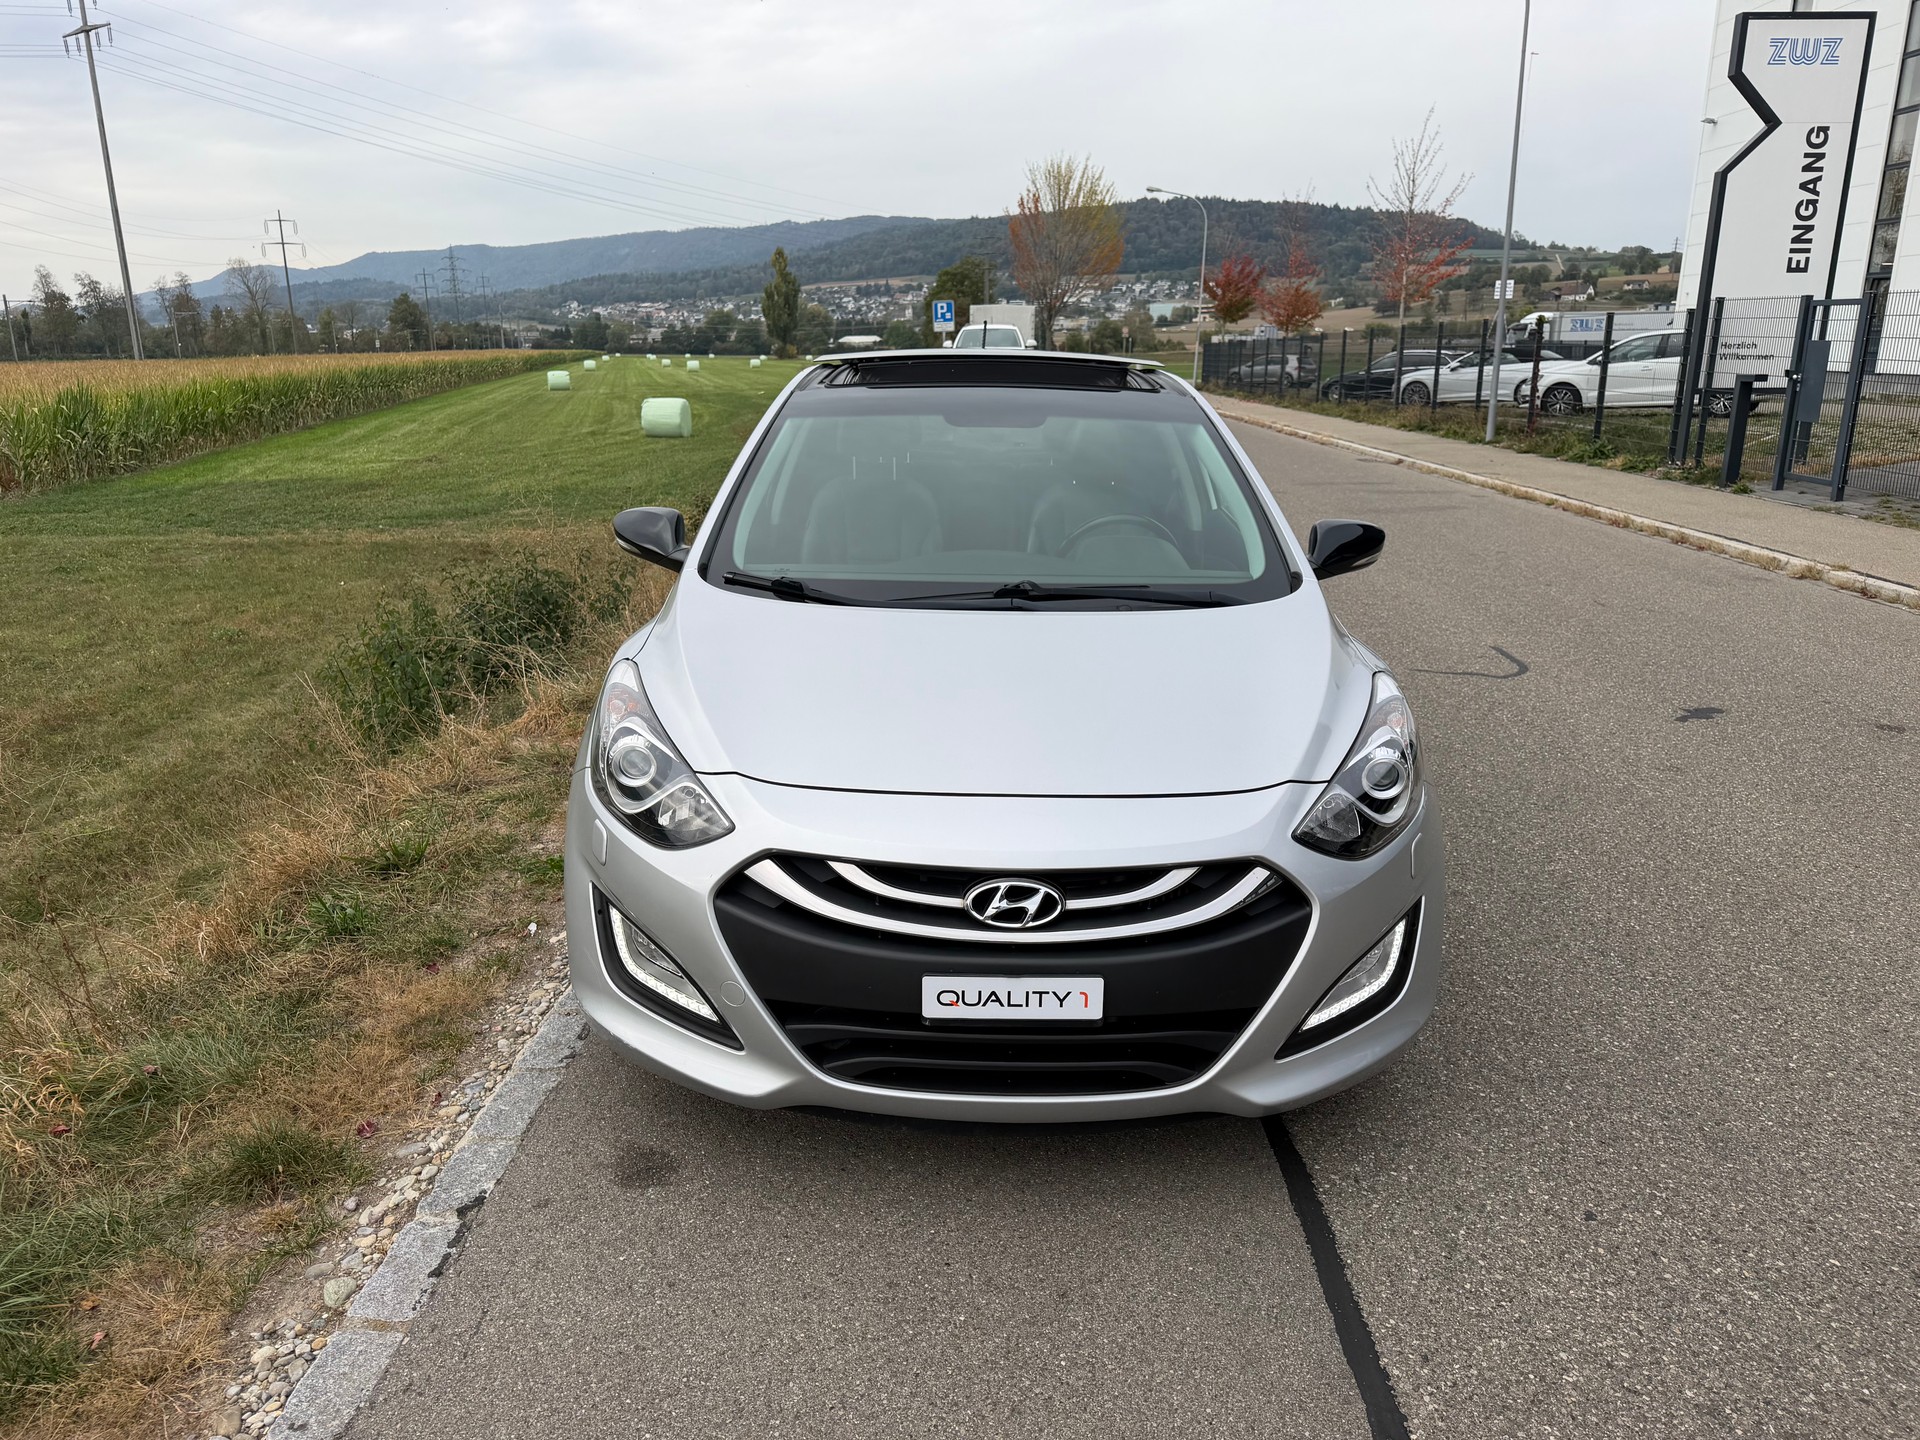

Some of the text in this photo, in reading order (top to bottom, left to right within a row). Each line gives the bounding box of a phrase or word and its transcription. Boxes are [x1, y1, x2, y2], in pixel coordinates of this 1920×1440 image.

[1767, 38, 1843, 65] ZWZ
[1786, 126, 1830, 273] EINGANG
[937, 303, 947, 318] P
[1720, 342, 1757, 350] Herzlich
[1719, 352, 1775, 360] Willkommen
[936, 990, 1089, 1008] QUALITY 1
